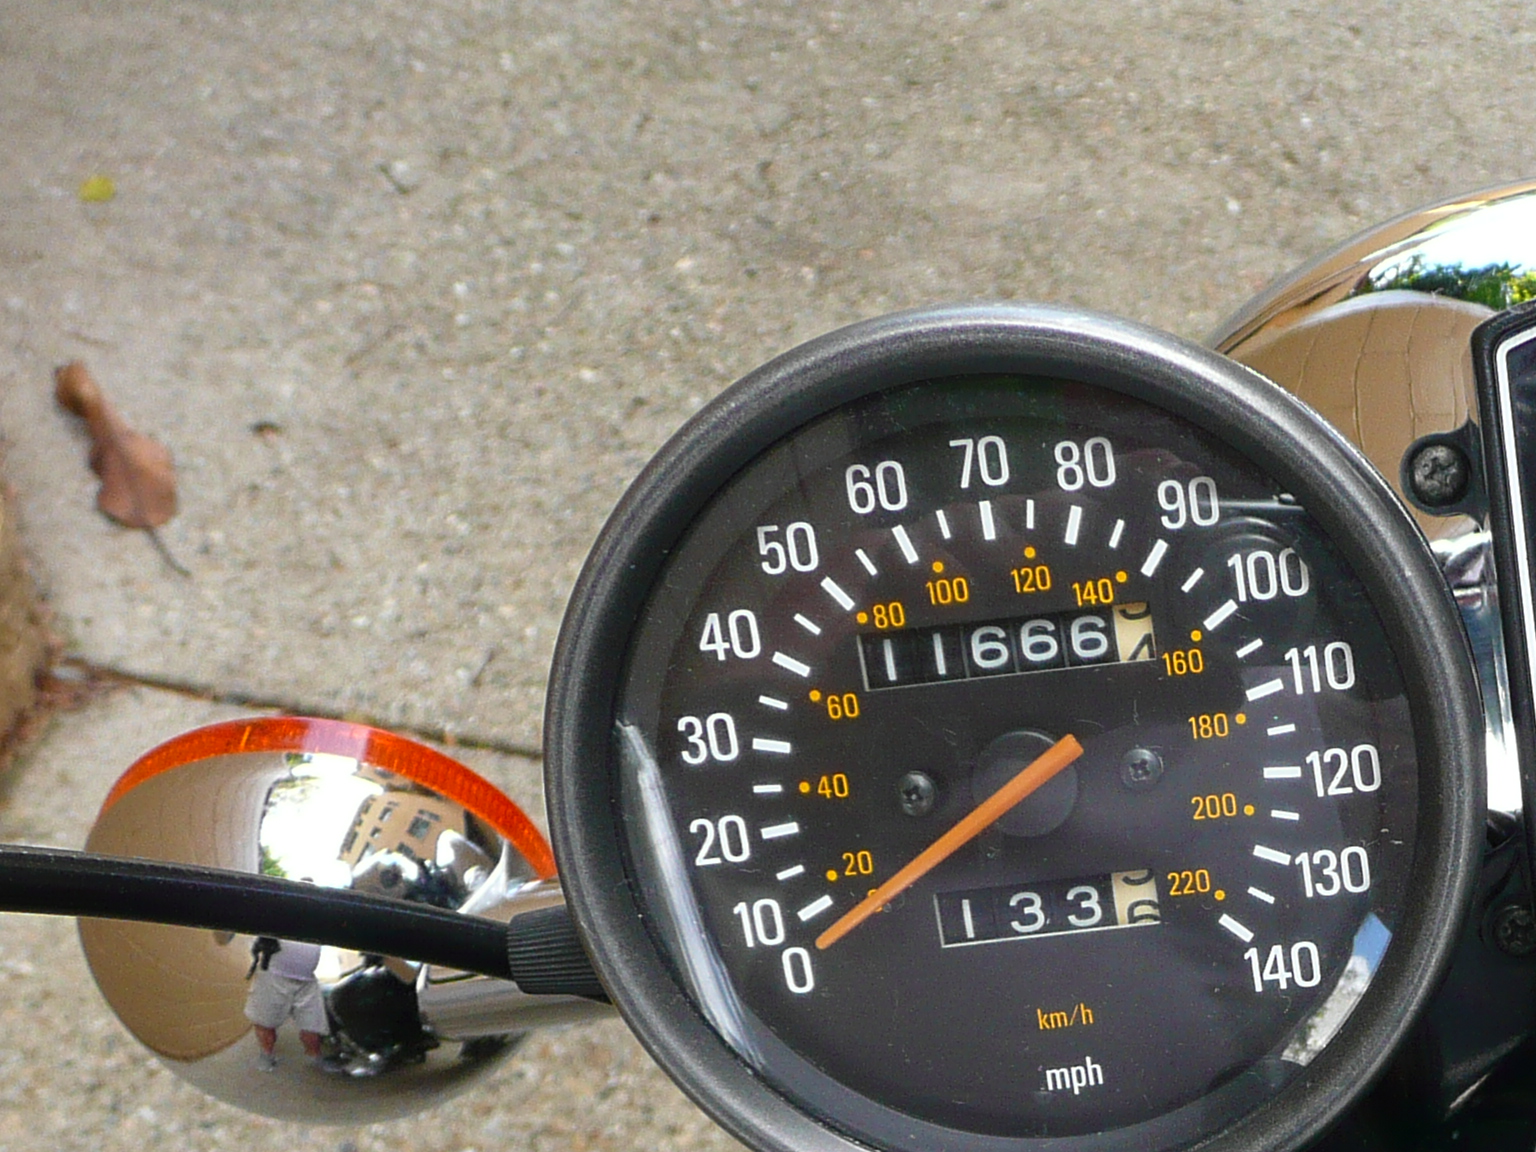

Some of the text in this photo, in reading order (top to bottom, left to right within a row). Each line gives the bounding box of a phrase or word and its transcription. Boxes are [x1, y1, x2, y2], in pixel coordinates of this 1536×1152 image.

[949, 435, 1010, 489] 70
[1053, 436, 1117, 492] 80
[845, 460, 909, 514] 60
[1157, 475, 1221, 530] 90
[756, 521, 819, 575] 50
[925, 575, 970, 606] 100
[1010, 563, 1053, 594] 120
[1071, 577, 1115, 607] 140
[1227, 547, 1310, 603] 100
[699, 608, 762, 661] 40
[872, 601, 906, 630] 80
[1161, 647, 1205, 676] 160
[1284, 640, 1356, 696] 110
[825, 692, 861, 720] 60
[1187, 711, 1230, 741] 180
[676, 712, 740, 765] 30
[816, 772, 850, 800] 40
[1305, 743, 1382, 799] 120
[1190, 791, 1238, 822] 200
[689, 814, 751, 867] 20
[841, 850, 875, 877] 20
[1166, 868, 1211, 897] 220
[1294, 845, 1371, 899] 130
[732, 898, 786, 948] 10
[781, 946, 815, 994] 0
[1243, 940, 1322, 993] 140
[1036, 1002, 1095, 1031] km/h
[1045, 1055, 1105, 1096] mph
